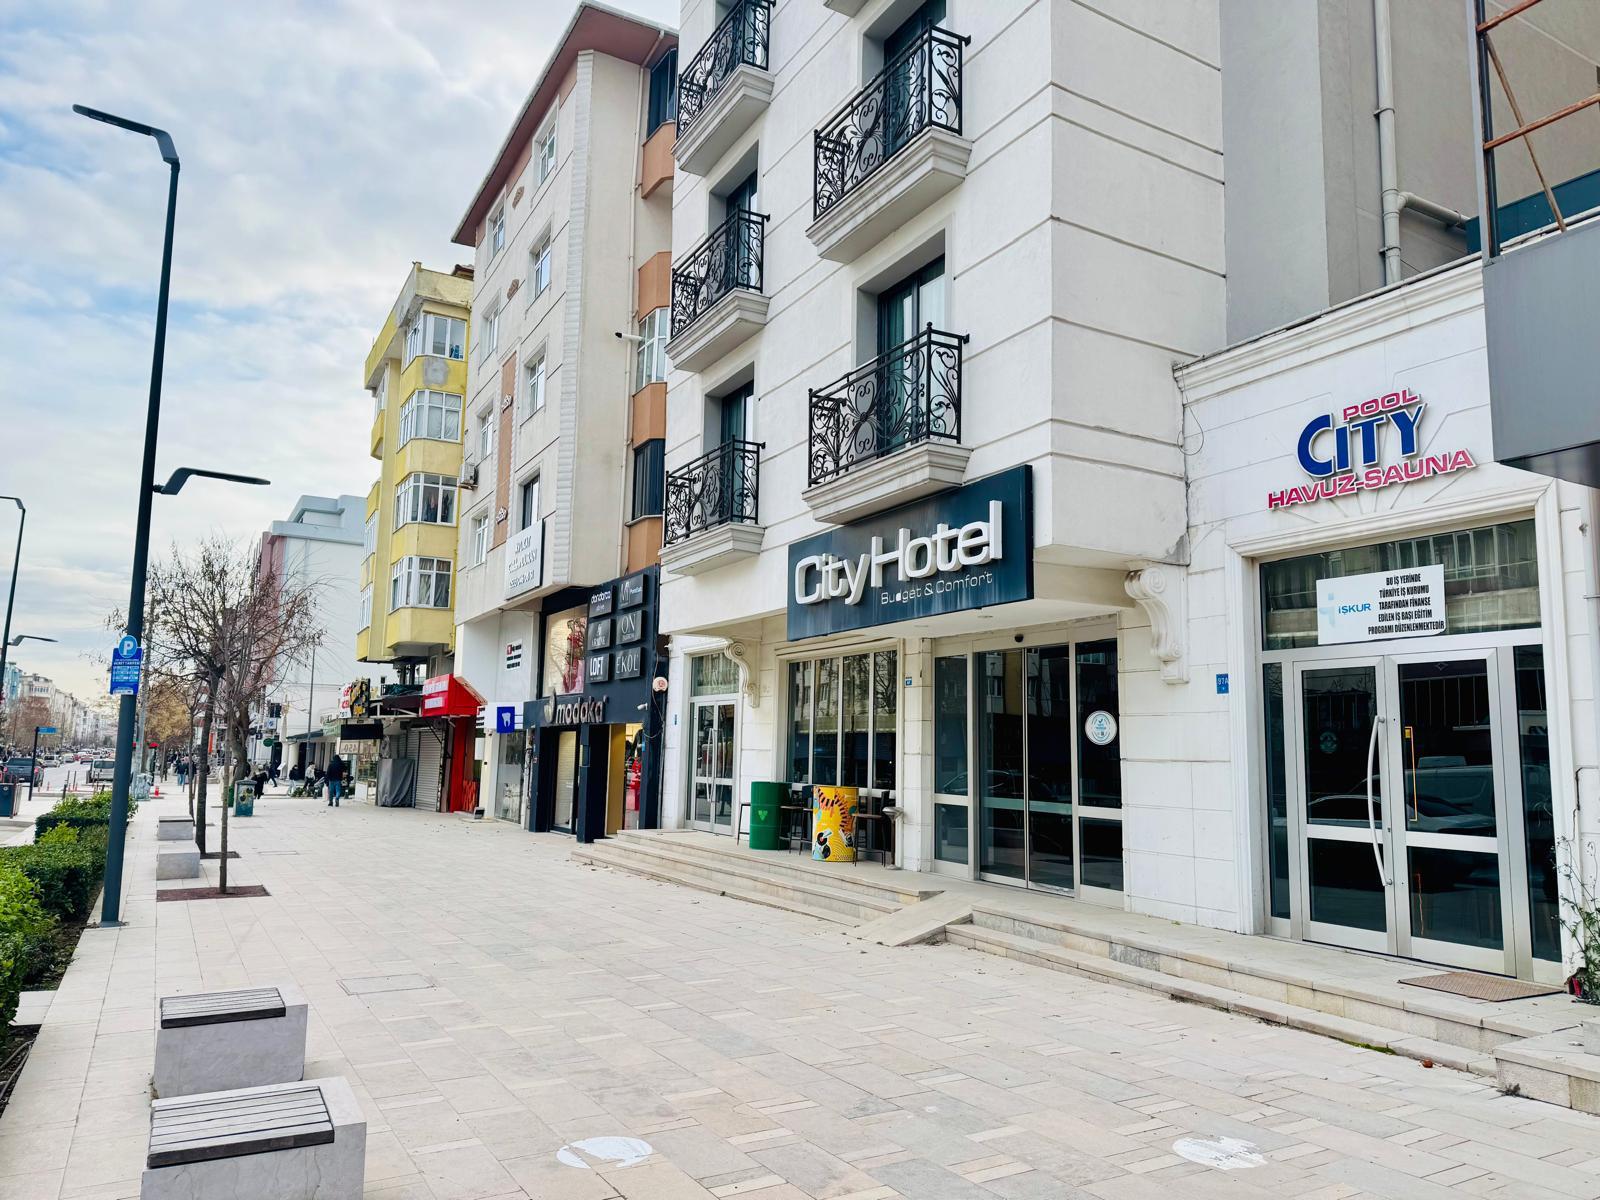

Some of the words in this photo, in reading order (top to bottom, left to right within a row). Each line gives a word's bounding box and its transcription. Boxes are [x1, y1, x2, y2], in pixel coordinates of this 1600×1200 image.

[1342, 388, 1418, 422] POOL
[1297, 403, 1426, 478] CITY
[1267, 449, 1475, 508] HAVUZ-SAUNA
[881, 587, 922, 605] Budget
[924, 582, 934, 596] &
[936, 571, 993, 594] Comfort
[123, 640, 134, 656] P
[589, 656, 604, 677] LOFT
[555, 695, 603, 725] modaka
